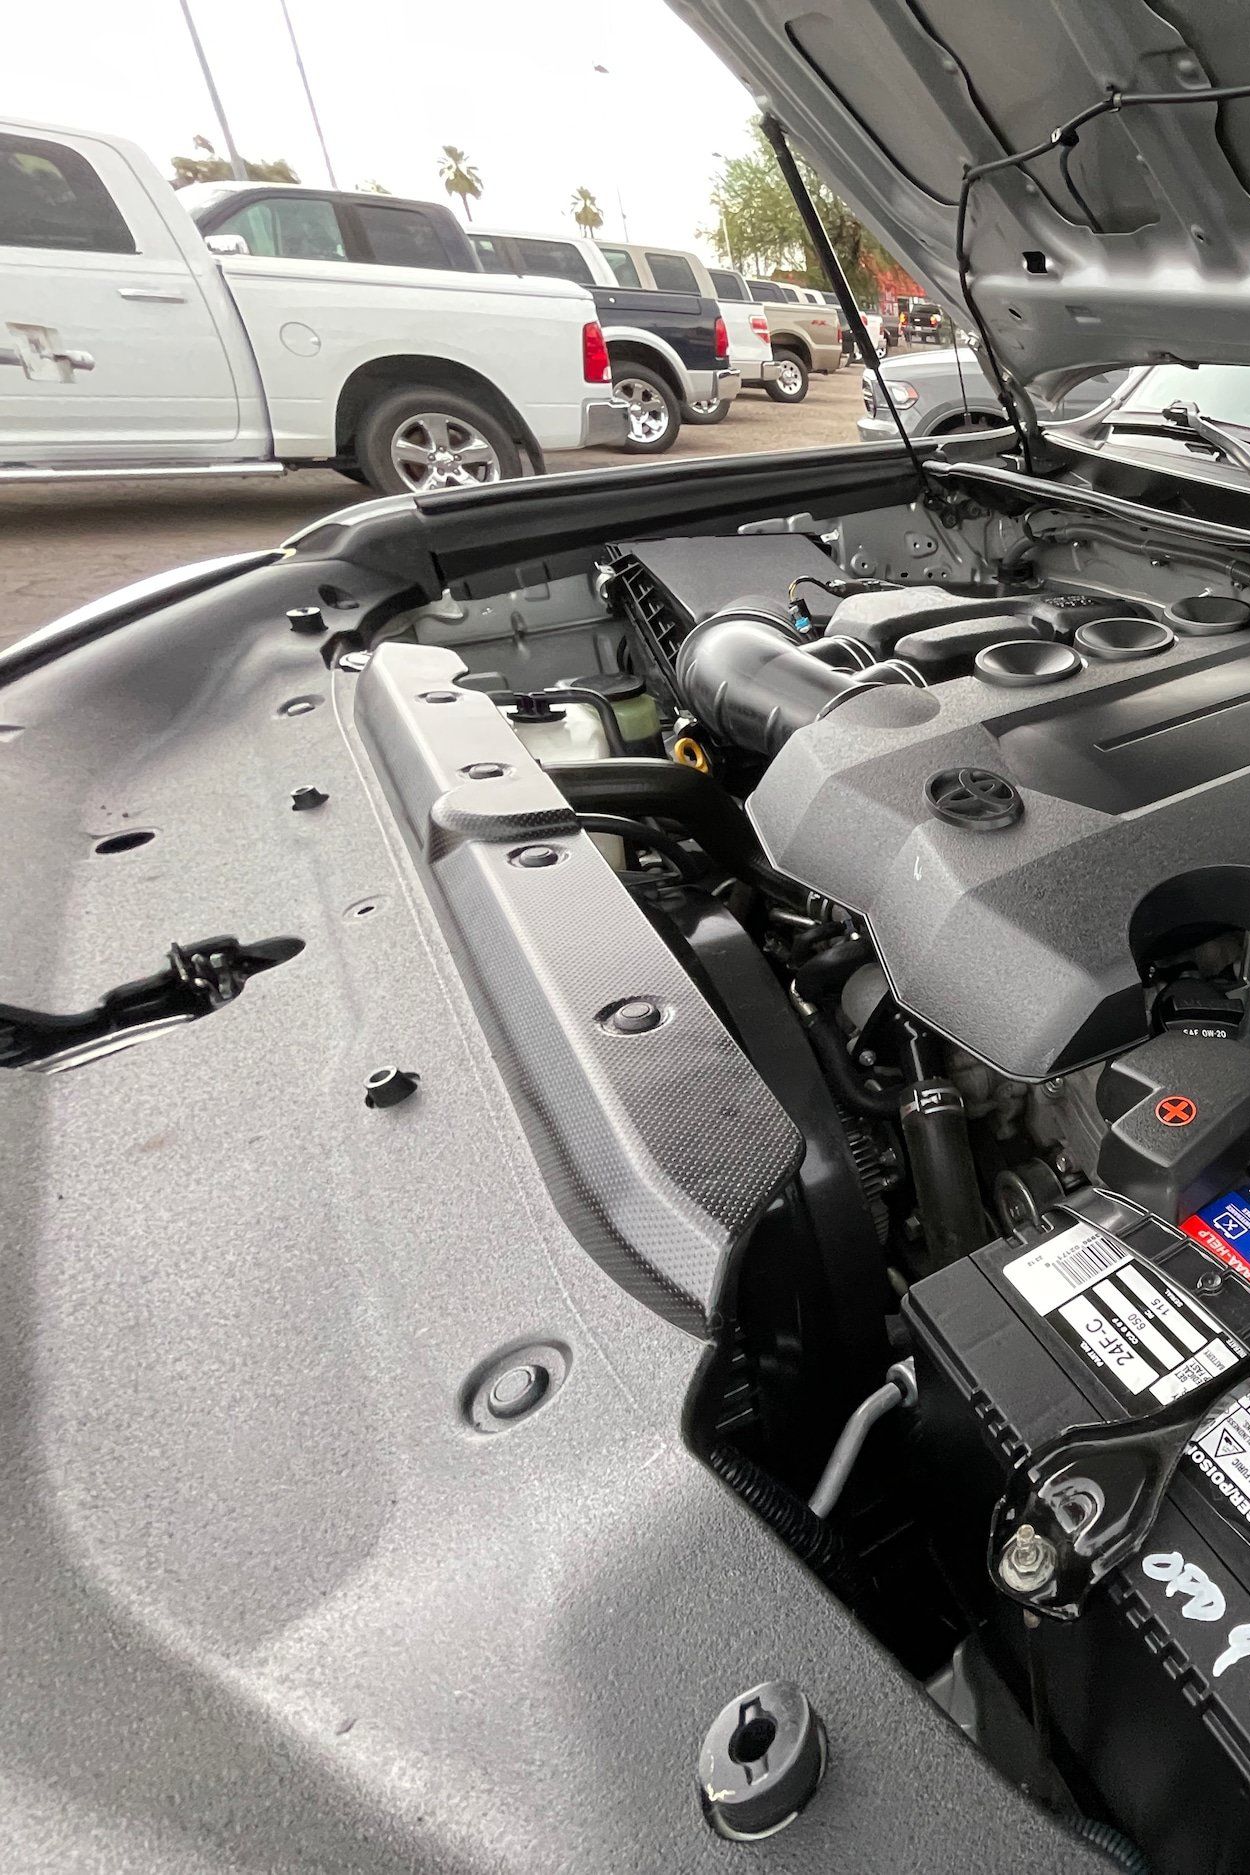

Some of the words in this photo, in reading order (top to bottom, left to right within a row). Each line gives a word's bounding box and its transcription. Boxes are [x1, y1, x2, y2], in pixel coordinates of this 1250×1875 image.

[1202, 1029, 1227, 1038] 0W-20
[1163, 1288, 1183, 1307] SERIAL
[1150, 1297, 1170, 1316] 115
[1127, 1312, 1146, 1330] 650
[1084, 1317, 1134, 1366] 24F-C
[1124, 1330, 1139, 1344] CCA
[1078, 1340, 1091, 1352] NO.
[1087, 1350, 1104, 1366] PART
[1174, 1370, 1187, 1382] GET
[1181, 1365, 1202, 1385] EDICAL
